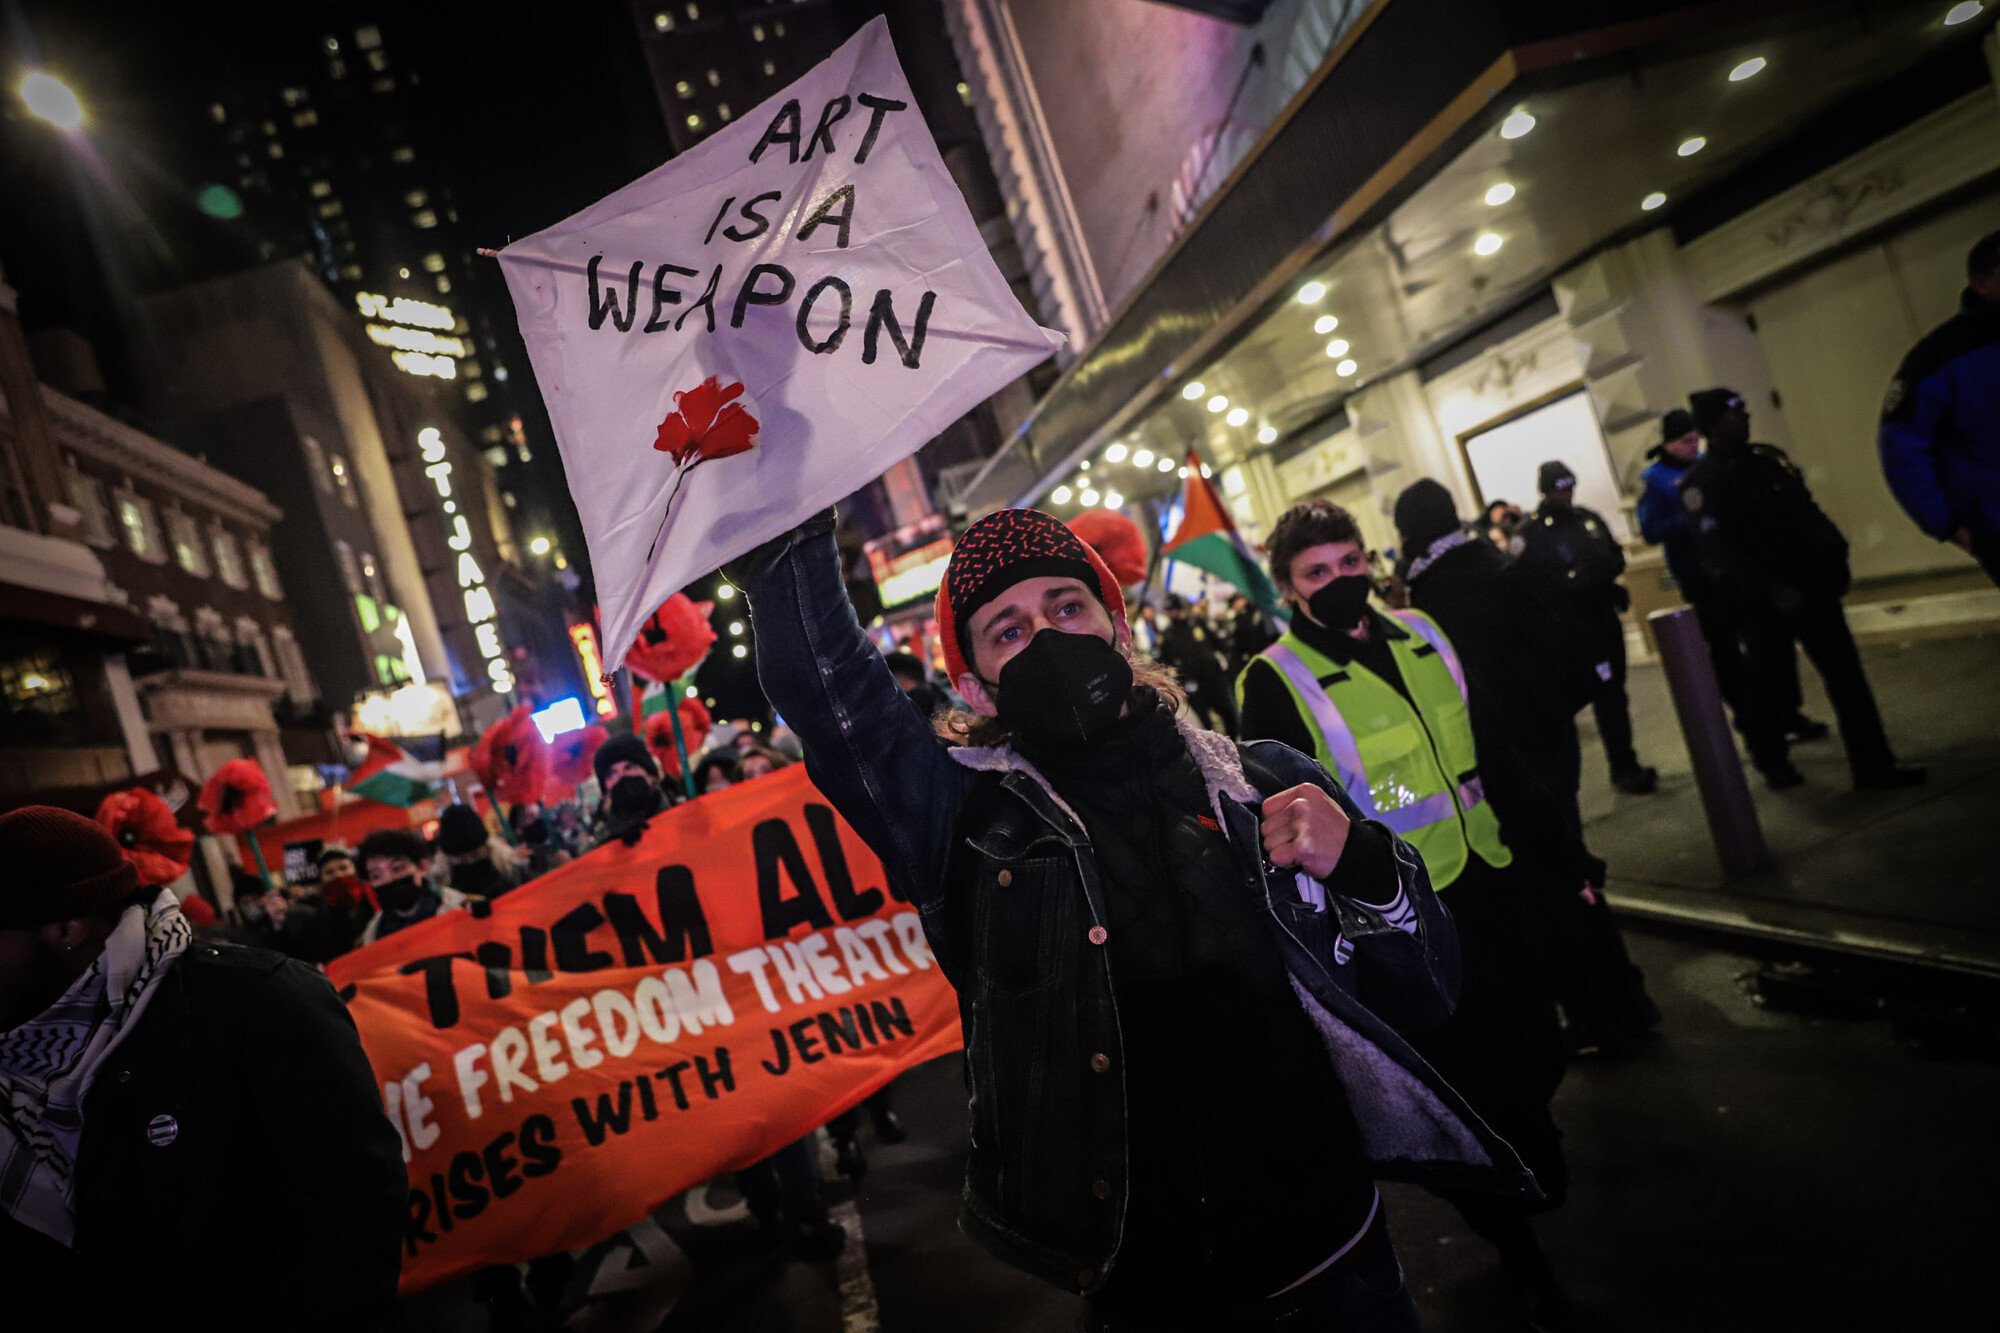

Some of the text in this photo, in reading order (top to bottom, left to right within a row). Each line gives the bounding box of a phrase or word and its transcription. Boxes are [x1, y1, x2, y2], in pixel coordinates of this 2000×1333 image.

[749, 92, 908, 165] ART
[703, 184, 855, 249] IS A
[587, 253, 938, 370] WEAPON
[447, 514, 515, 694] JAMES
[400, 864, 715, 1029] THEM
[453, 959, 734, 1119] FREEDOM
[404, 1114, 563, 1257] RISES
[571, 1047, 737, 1147] WITH
[762, 997, 915, 1076] JENIN
